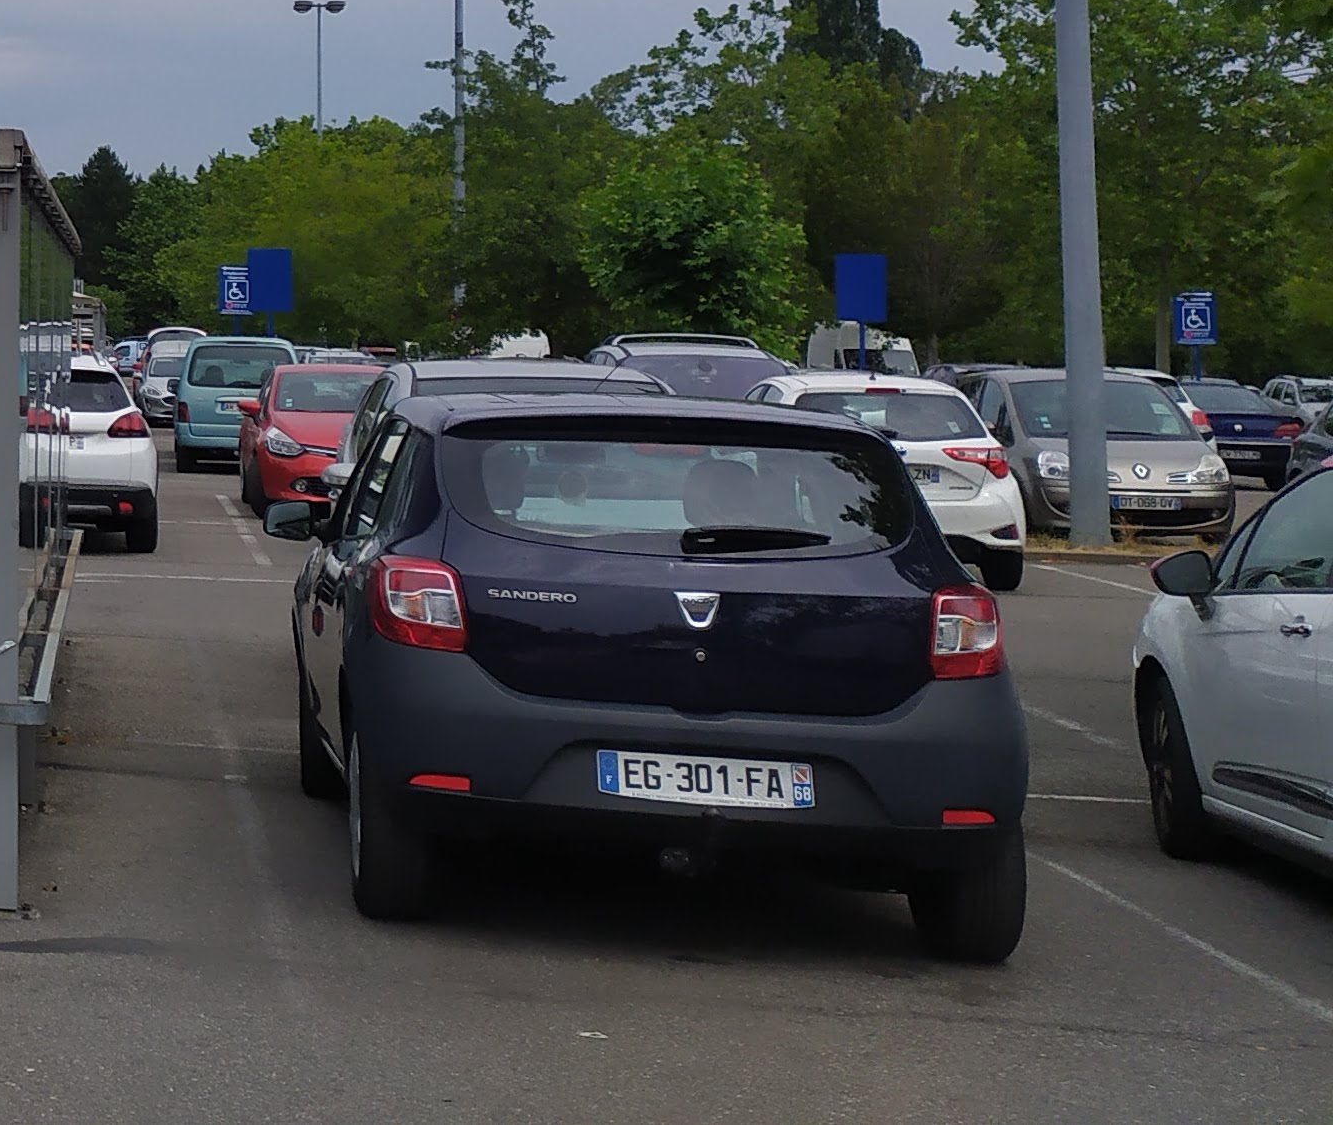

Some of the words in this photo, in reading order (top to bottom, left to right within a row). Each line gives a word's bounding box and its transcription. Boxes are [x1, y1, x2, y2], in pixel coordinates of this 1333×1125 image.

[487, 588, 578, 603] SANDERO
[605, 775, 613, 784] F
[623, 758, 785, 799] EG-301-FA
[794, 784, 812, 802] 68
